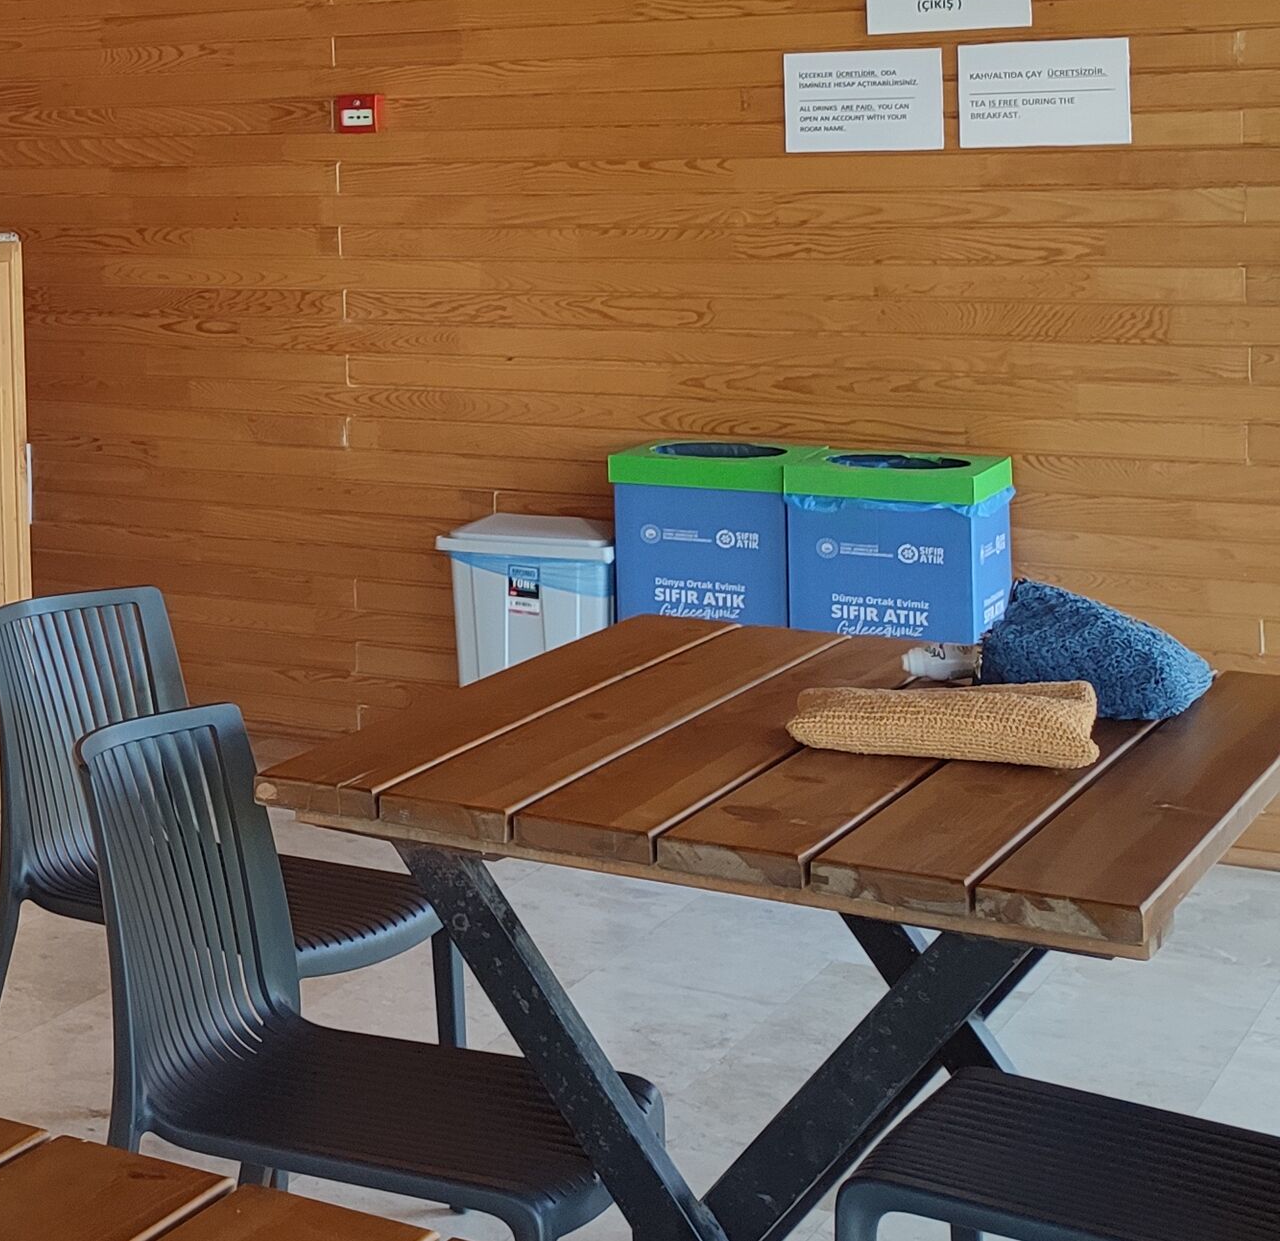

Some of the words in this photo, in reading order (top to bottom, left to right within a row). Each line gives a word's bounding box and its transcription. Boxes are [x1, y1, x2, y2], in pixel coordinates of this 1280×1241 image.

[880, 69, 897, 77] ODA
[969, 71, 1024, 80] KAHVALTIDA
[1025, 70, 1042, 80] ÇAY
[833, 80, 855, 88] HESAP
[970, 99, 986, 108] TEA
[998, 99, 1018, 108] FREE
[1021, 97, 1057, 106] DURING
[1059, 96, 1075, 105] THE
[799, 105, 811, 113] ALL
[812, 104, 838, 112] DRINKS
[840, 104, 854, 112] ARE
[799, 115, 818, 123] OPEN
[831, 114, 865, 122] ACCOUNT
[887, 113, 907, 121] YOUR
[735, 532, 759, 541] SIFIR
[736, 540, 759, 549] ATIK
[920, 546, 944, 556] SIFIR
[920, 555, 944, 565] ATIK
[655, 577, 684, 588] Dünya
[686, 580, 712, 589] Ortak
[715, 582, 746, 592] Evimiz
[654, 588, 699, 604] SIFIR
[703, 592, 745, 609] ATIK
[831, 593, 863, 605] Dünya
[865, 596, 894, 606] Ortak
[896, 598, 929, 609] Evimiz
[831, 604, 879, 622] SIFIR
[883, 608, 930, 627] ATIK
